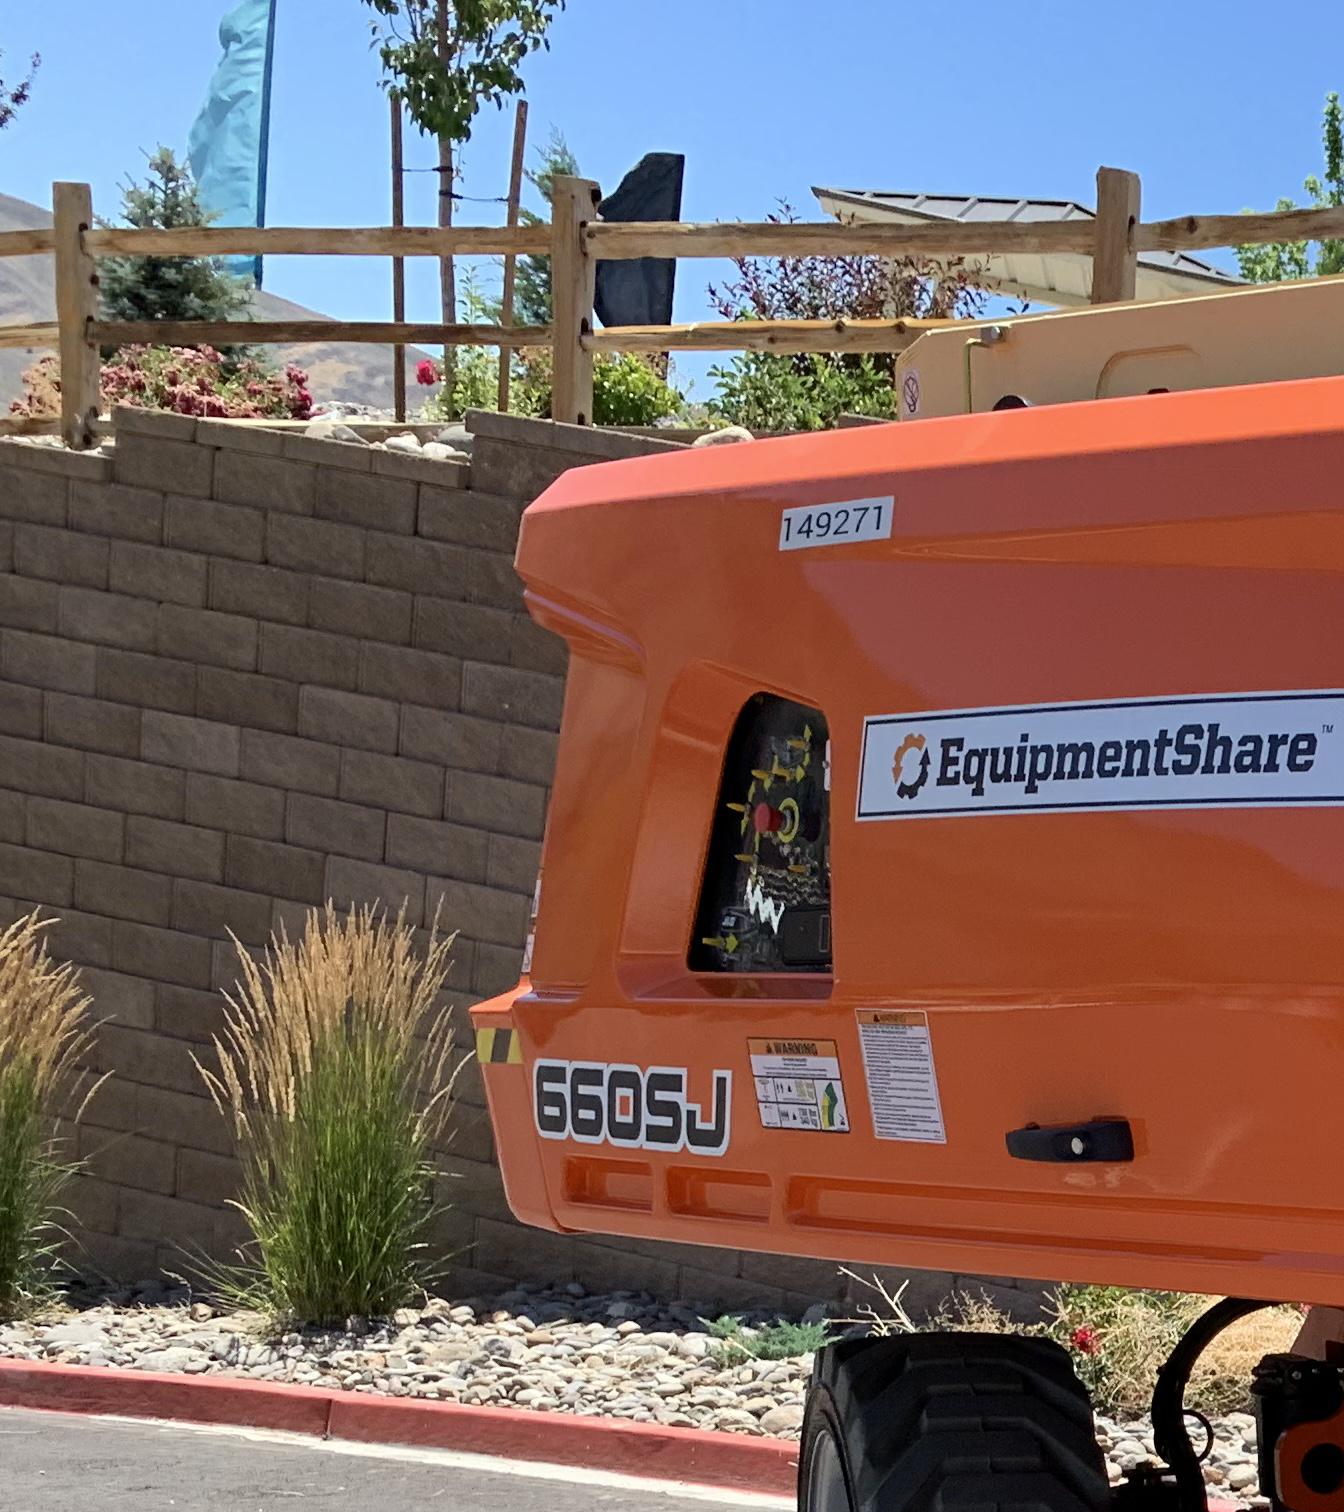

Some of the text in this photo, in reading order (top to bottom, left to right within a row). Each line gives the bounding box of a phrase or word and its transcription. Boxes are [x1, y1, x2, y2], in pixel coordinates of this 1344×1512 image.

[783, 505, 883, 542] 149271
[935, 723, 1318, 798] EquipmentShare
[773, 1041, 819, 1056] WARNING
[534, 1062, 730, 1151] 660SJ
